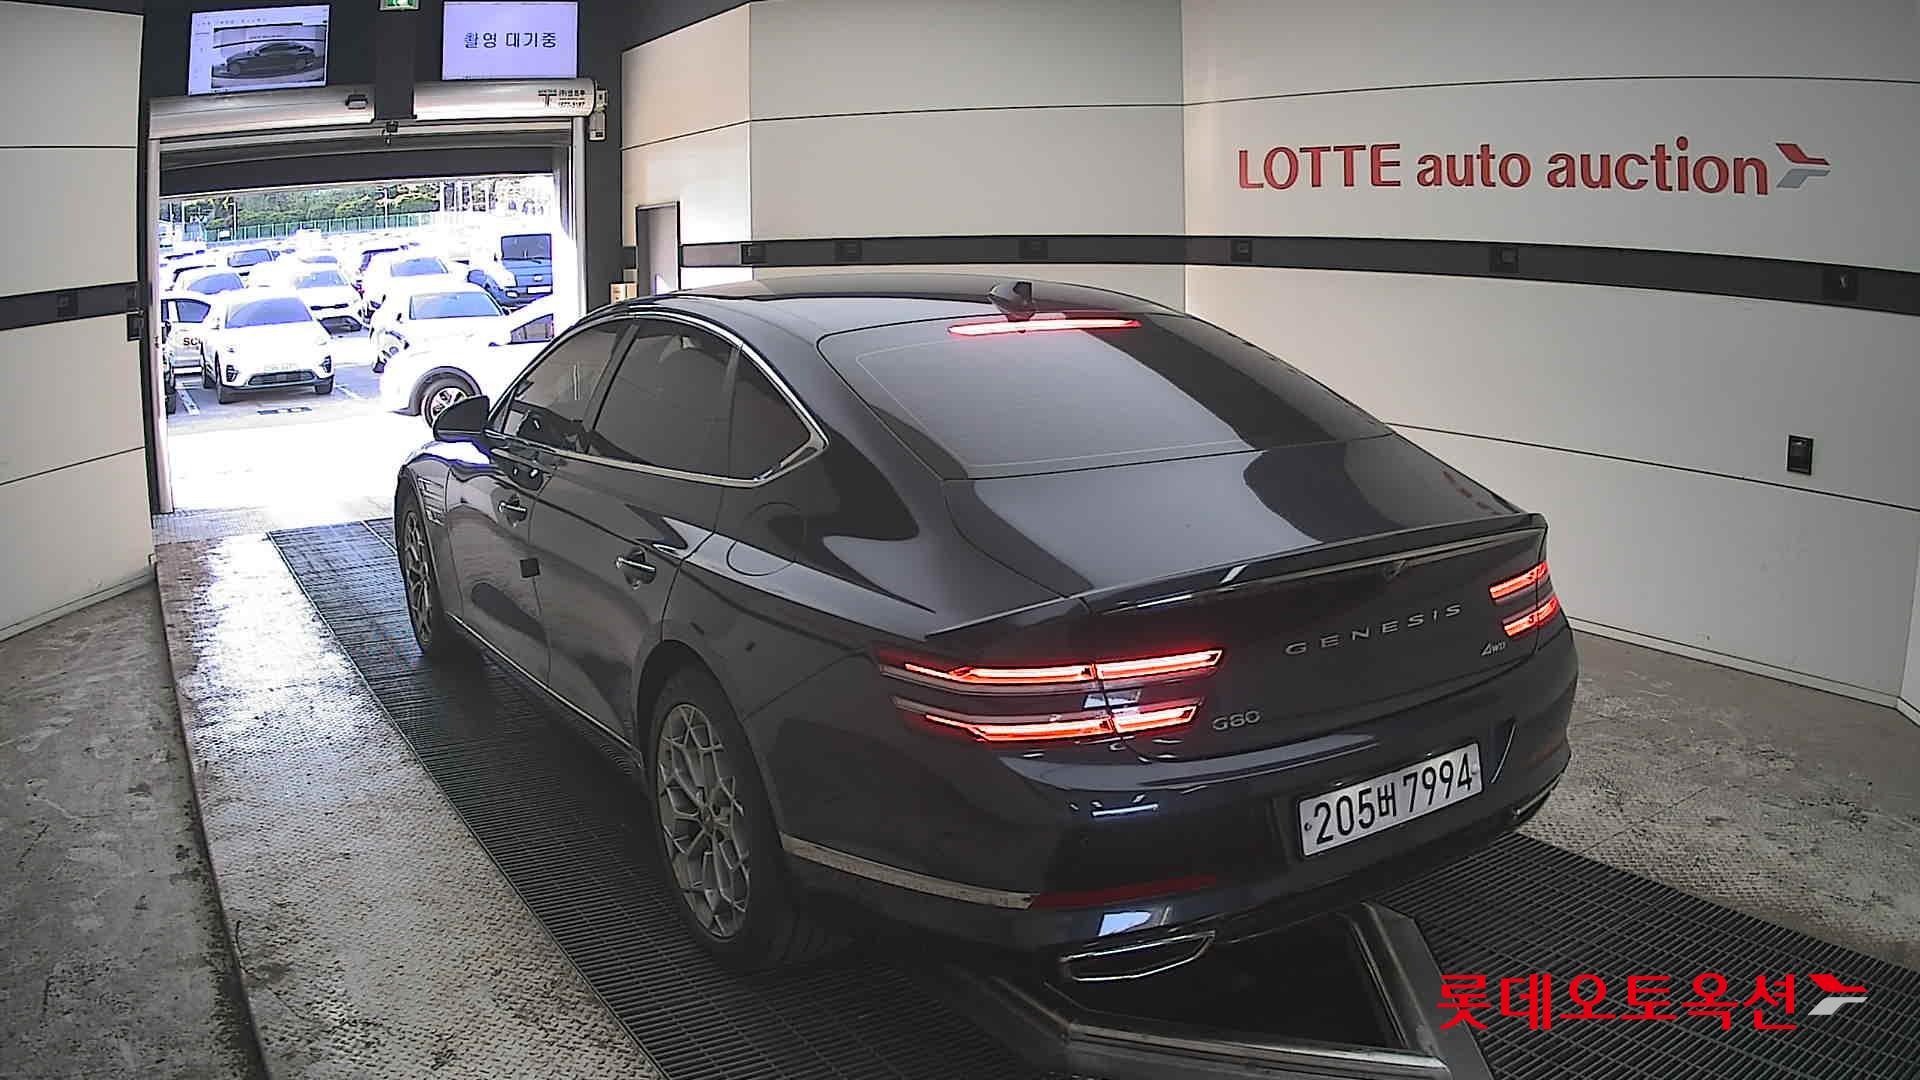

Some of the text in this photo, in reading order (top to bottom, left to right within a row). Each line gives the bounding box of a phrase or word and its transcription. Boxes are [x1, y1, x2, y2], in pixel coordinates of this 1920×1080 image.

[505, 32, 557, 49] 대기중
[1238, 136, 1769, 195] LOTTE auto auction
[1285, 603, 1462, 656] GENESIS
[1212, 710, 1262, 732] G80
[1313, 753, 1473, 845] 205버 7994
